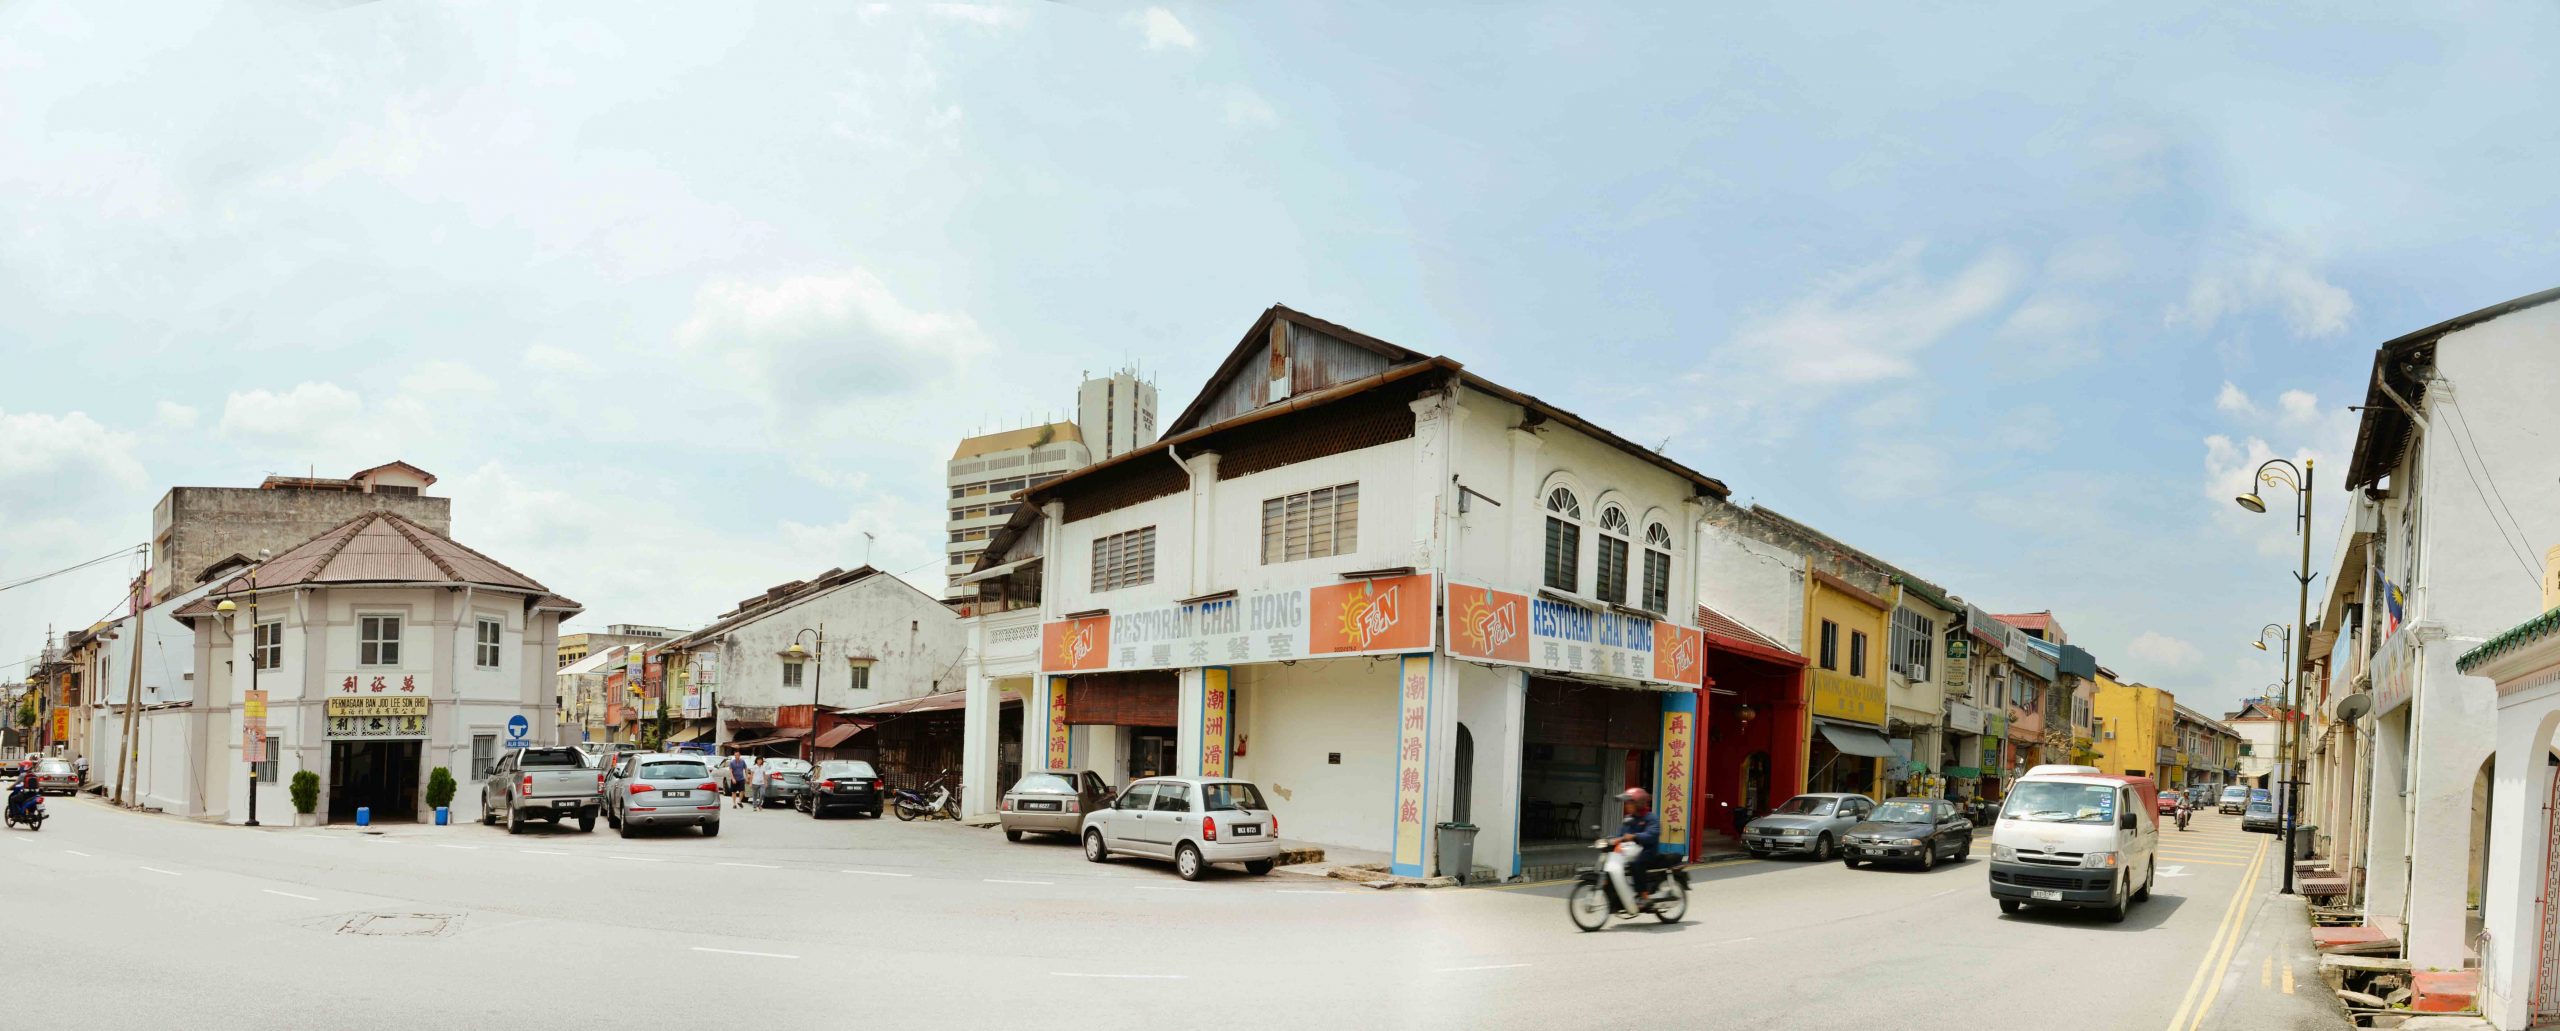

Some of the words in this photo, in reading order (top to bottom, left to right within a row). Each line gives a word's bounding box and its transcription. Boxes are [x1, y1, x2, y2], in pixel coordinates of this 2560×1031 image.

[1114, 605, 1194, 644] RESTORAN
[1200, 599, 1241, 636] CHAI
[1250, 590, 1302, 631] HONG
[1356, 585, 1399, 648] F&N
[1479, 601, 1516, 655] F&N
[1533, 599, 1593, 643] RESTORAN
[1599, 609, 1623, 647] CHAI
[1627, 616, 1652, 652] HONG
[1069, 623, 1093, 669] F&N
[1671, 635, 1694, 679] F&N
[366, 699, 376, 708] BAN
[390, 698, 400, 708] LEE
